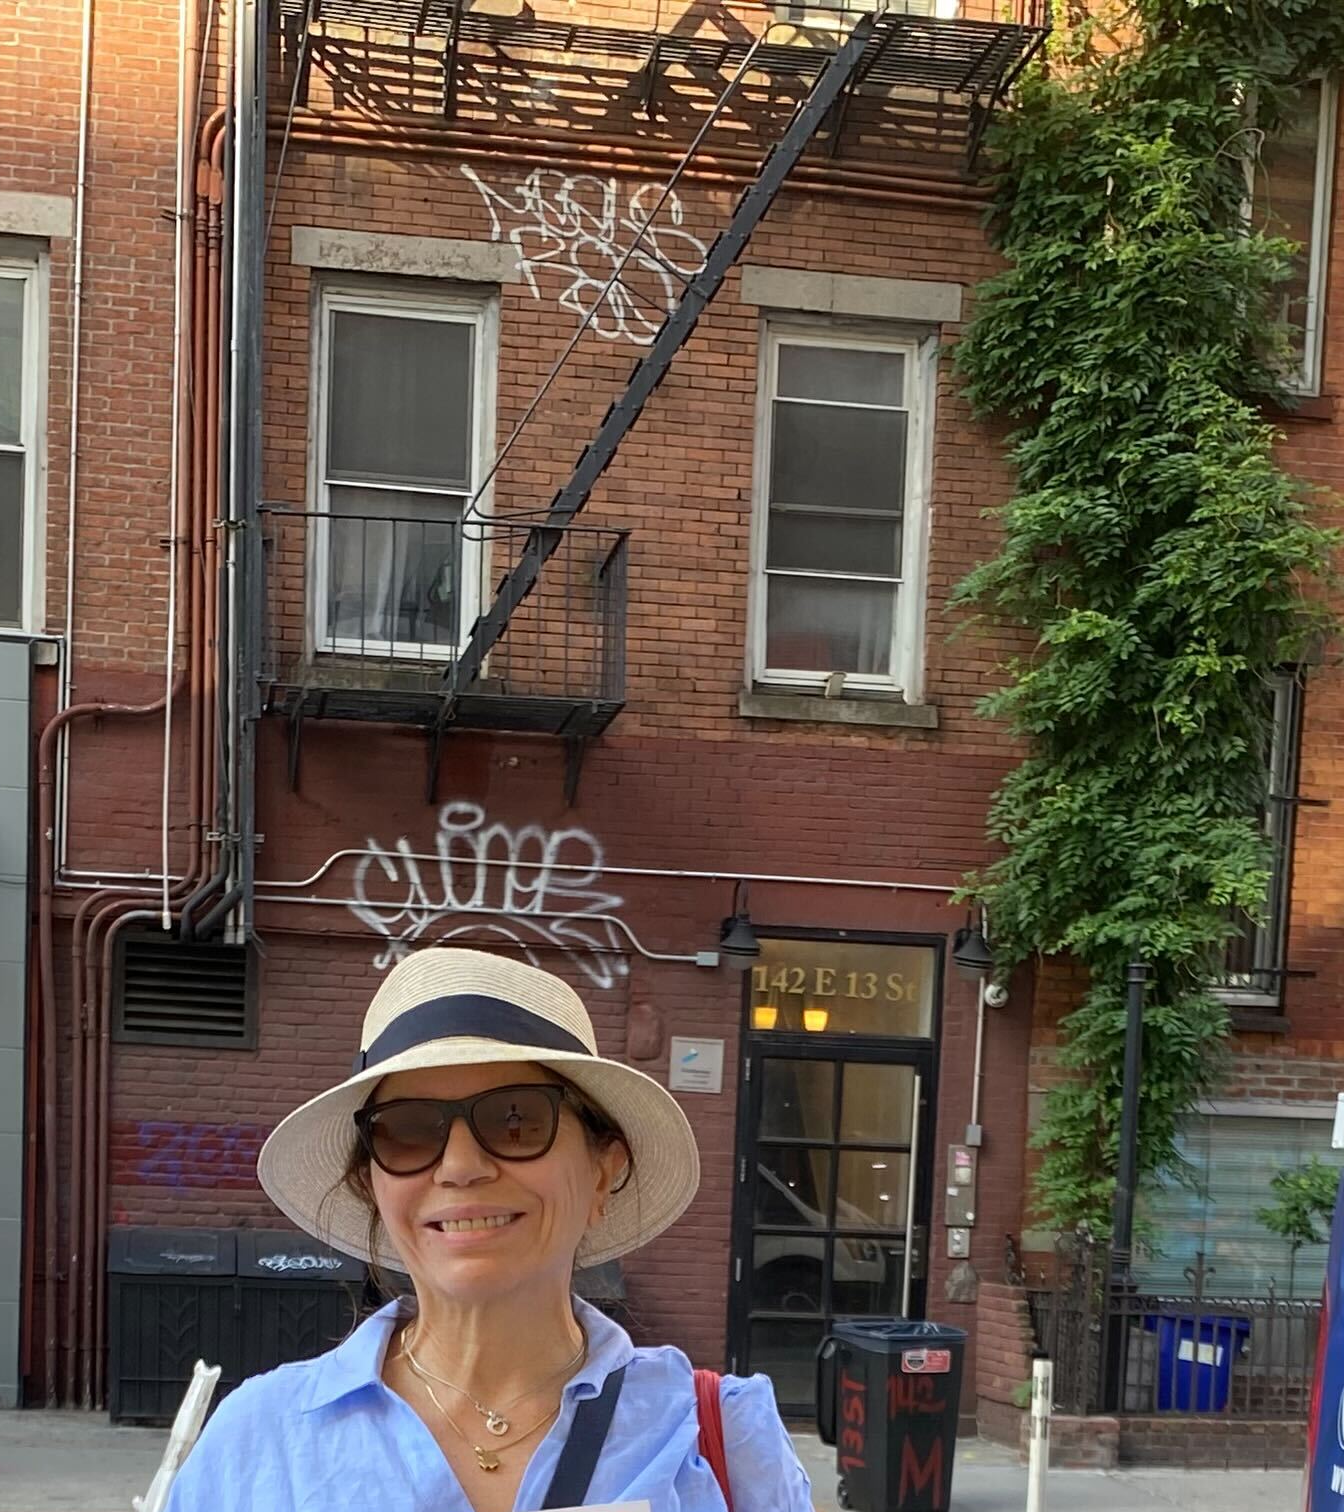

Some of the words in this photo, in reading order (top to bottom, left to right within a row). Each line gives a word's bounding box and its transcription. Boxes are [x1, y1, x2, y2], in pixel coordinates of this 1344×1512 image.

[752, 965, 806, 994] 142
[813, 968, 836, 996] E
[845, 972, 878, 999] 13
